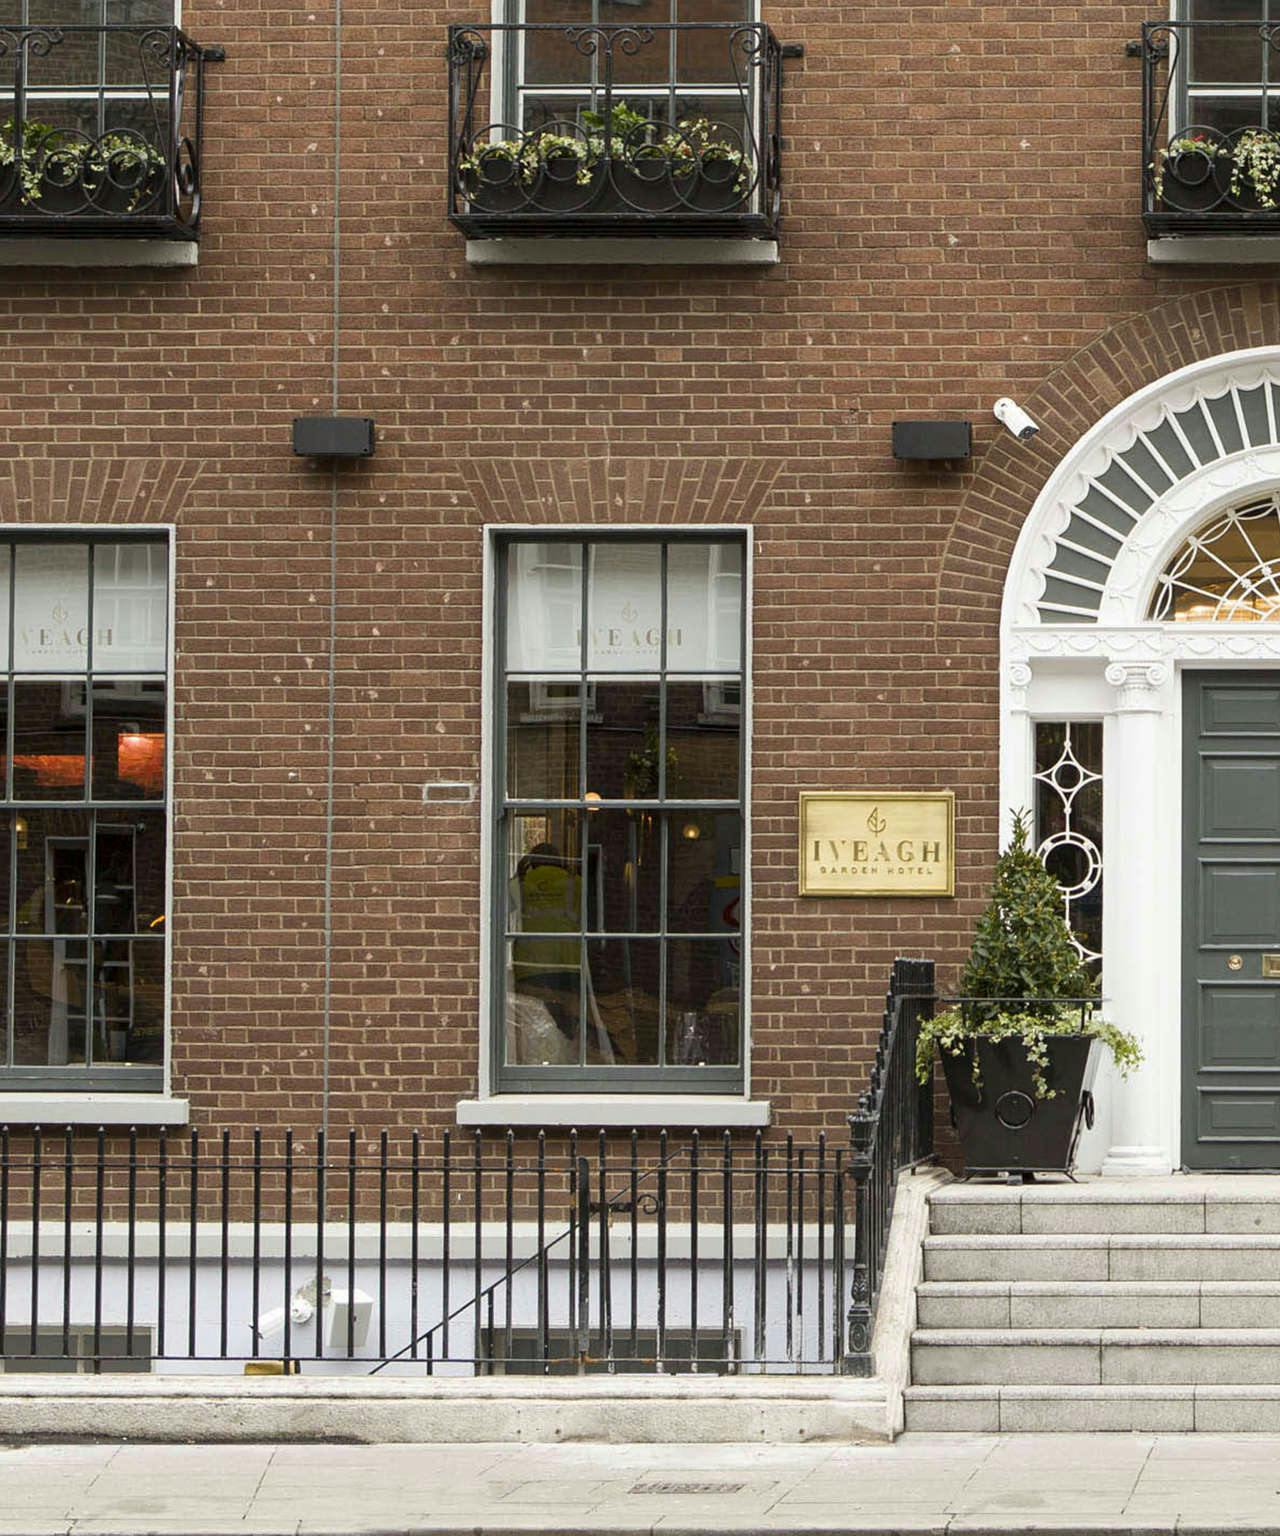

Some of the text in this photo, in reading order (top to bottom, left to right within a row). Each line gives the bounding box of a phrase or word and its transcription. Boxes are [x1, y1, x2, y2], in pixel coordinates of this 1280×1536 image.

[20, 628, 113, 646] VEAGH
[813, 840, 941, 863] IVEAGH
[820, 866, 934, 875] GARDEN HOTEL
